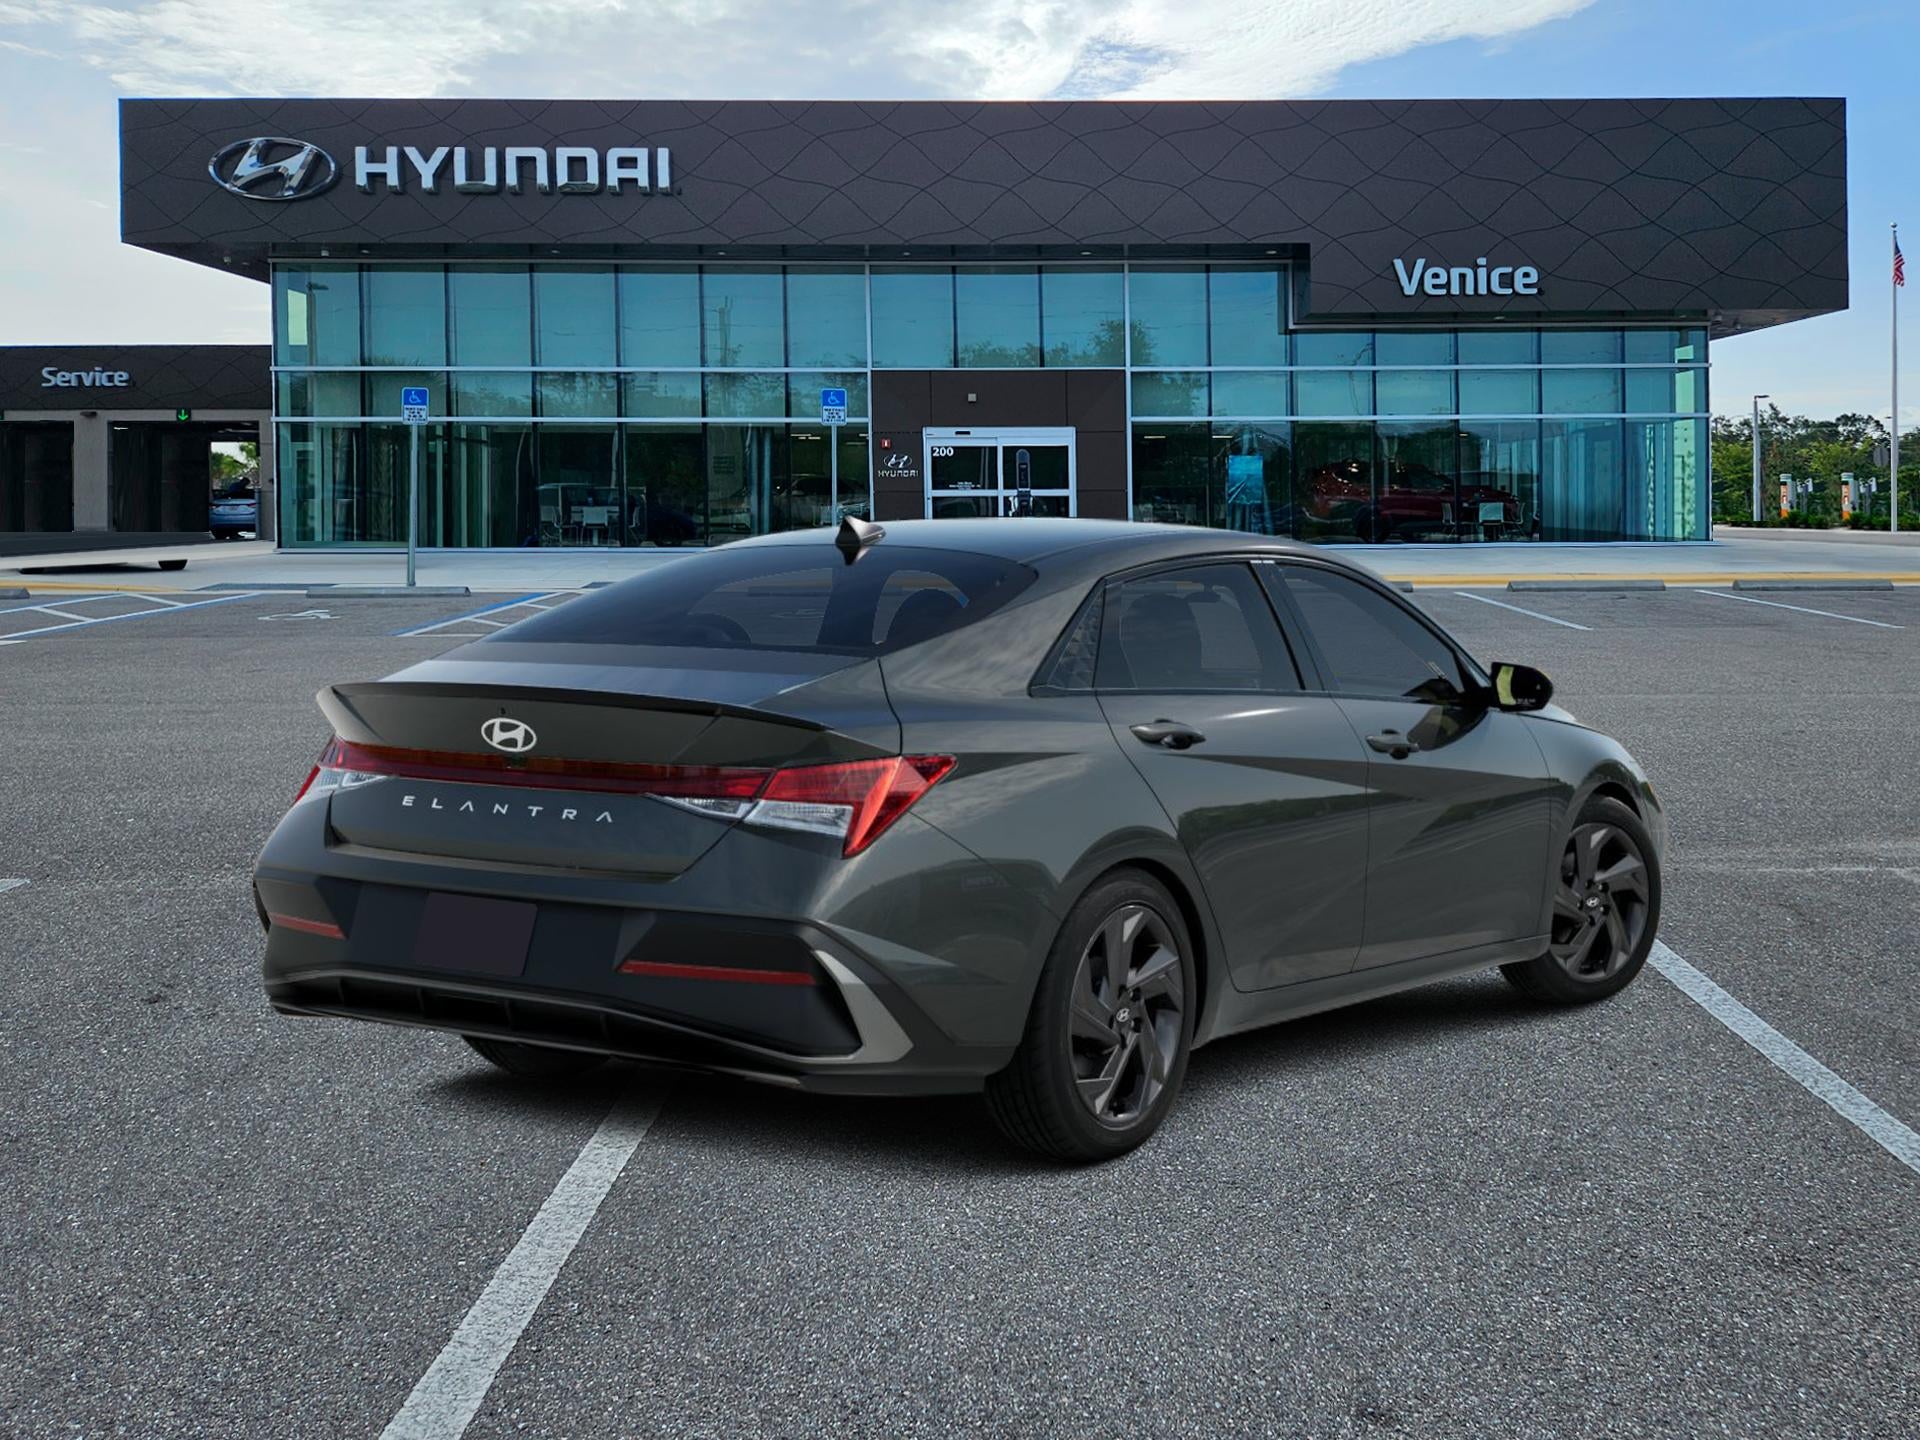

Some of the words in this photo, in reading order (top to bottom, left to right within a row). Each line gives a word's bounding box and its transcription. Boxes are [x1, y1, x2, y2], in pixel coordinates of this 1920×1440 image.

[354, 146, 671, 194] HYUNDAI
[1392, 256, 1539, 296] Venice
[41, 366, 129, 387] Service
[932, 447, 954, 457] 200
[877, 470, 919, 478] HYUNDAI
[401, 795, 613, 823] ELANTRA
